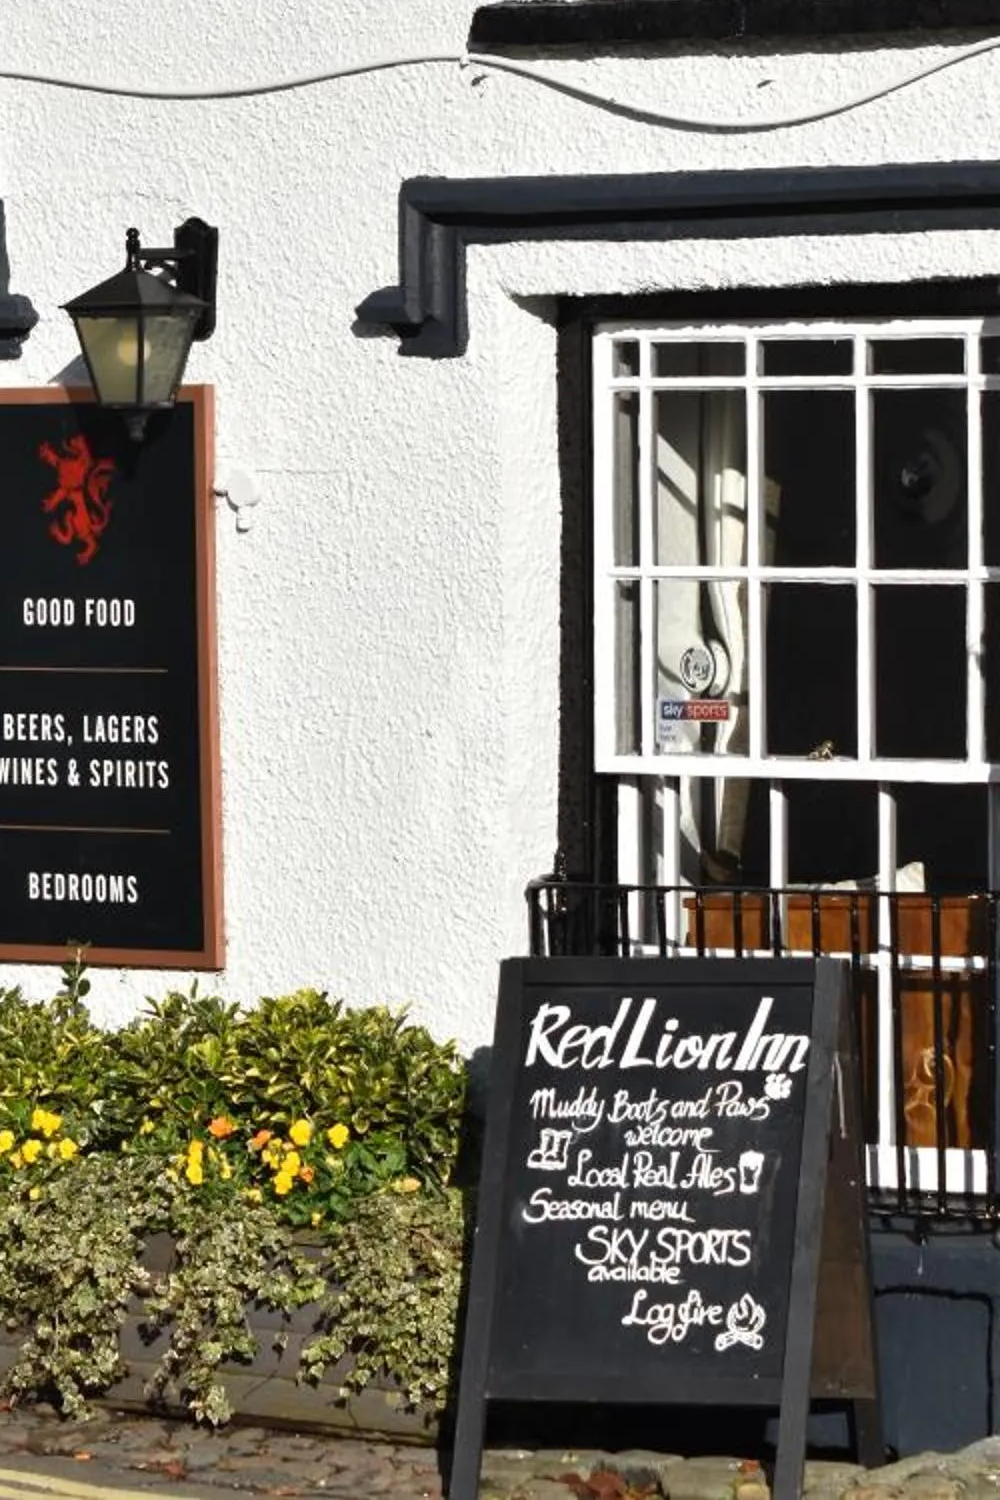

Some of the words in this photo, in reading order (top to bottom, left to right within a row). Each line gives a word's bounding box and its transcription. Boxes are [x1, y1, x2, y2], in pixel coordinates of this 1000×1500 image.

[23, 597, 76, 626] GOOD
[84, 598, 136, 627] FOOD
[663, 703, 684, 718] sky
[686, 704, 728, 718] sports
[2, 713, 73, 746] BEERS,
[83, 715, 160, 744] LAGERS
[67, 758, 81, 787] &
[89, 759, 170, 788] SPIRITS
[28, 872, 139, 903] BEDROOMS
[525, 998, 633, 1069] Red
[619, 998, 738, 1070] Lion
[732, 997, 811, 1073] Inn
[530, 1086, 606, 1133] Muddy
[607, 1088, 671, 1126] Boots
[671, 1087, 713, 1119] and
[716, 1080, 771, 1121] Paws
[624, 1122, 720, 1152] welcome
[567, 1148, 630, 1189] Local
[633, 1151, 681, 1189] Real
[680, 1152, 737, 1196] Ales
[522, 1188, 625, 1223] Seasonal
[630, 1200, 696, 1223] menu
[575, 1225, 650, 1265] SKY
[650, 1227, 752, 1267] SPORTS
[587, 1261, 686, 1284] available
[621, 1288, 675, 1345] Log
[671, 1288, 724, 1342] fire
